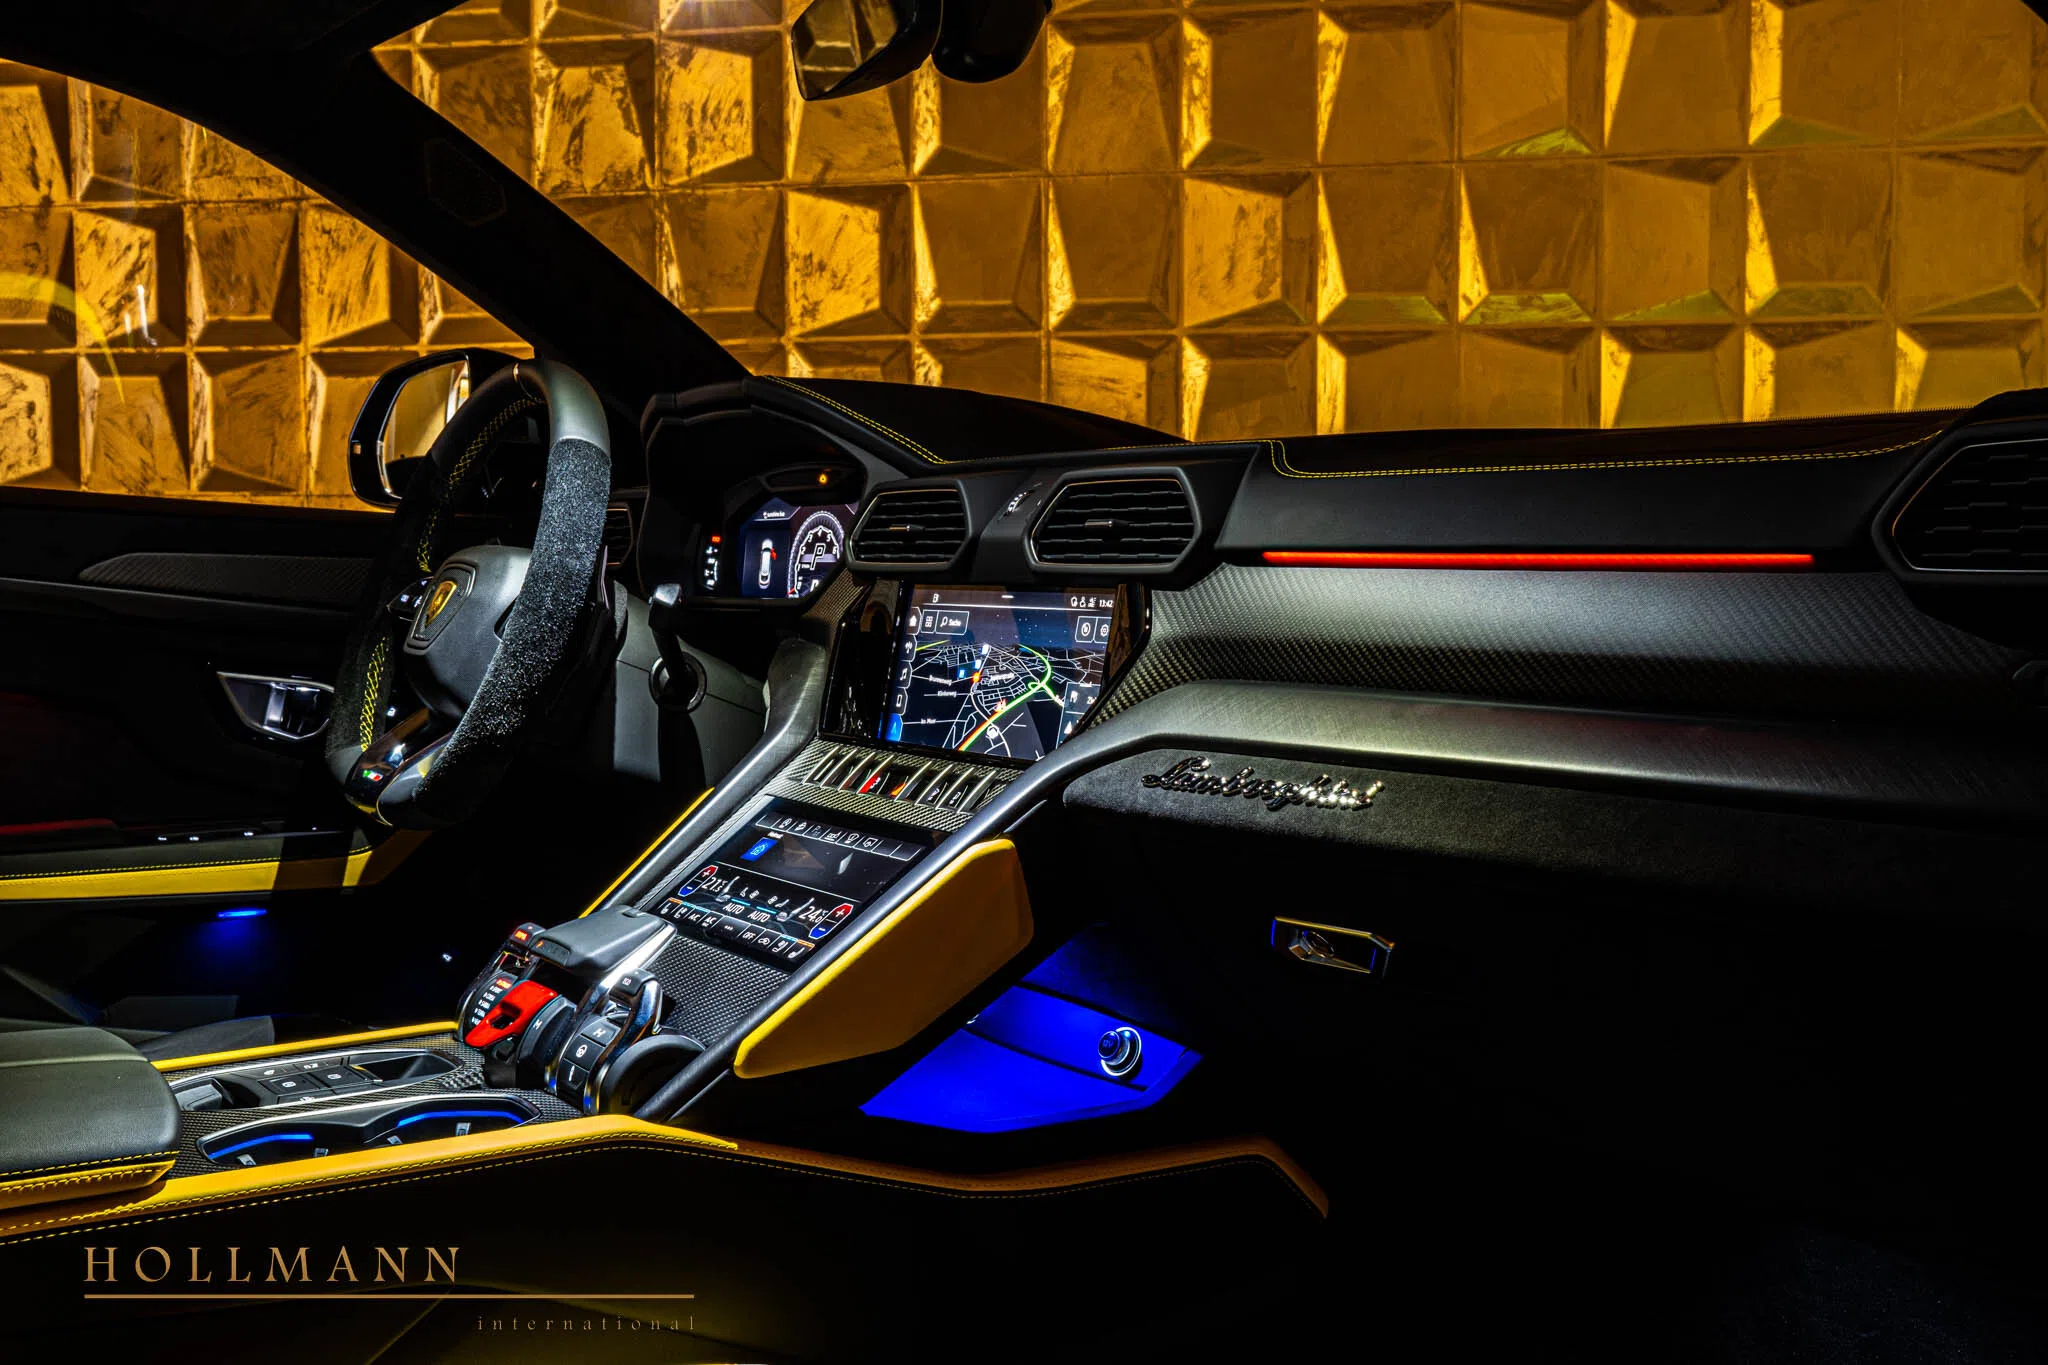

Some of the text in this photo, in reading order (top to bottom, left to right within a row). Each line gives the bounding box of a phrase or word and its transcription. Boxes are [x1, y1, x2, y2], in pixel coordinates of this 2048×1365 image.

[1141, 756, 1385, 812] Lamborghini
[722, 902, 745, 914] AUTO
[688, 913, 701, 922] AC
[747, 910, 771, 923] AUTO
[742, 931, 756, 940] OFF
